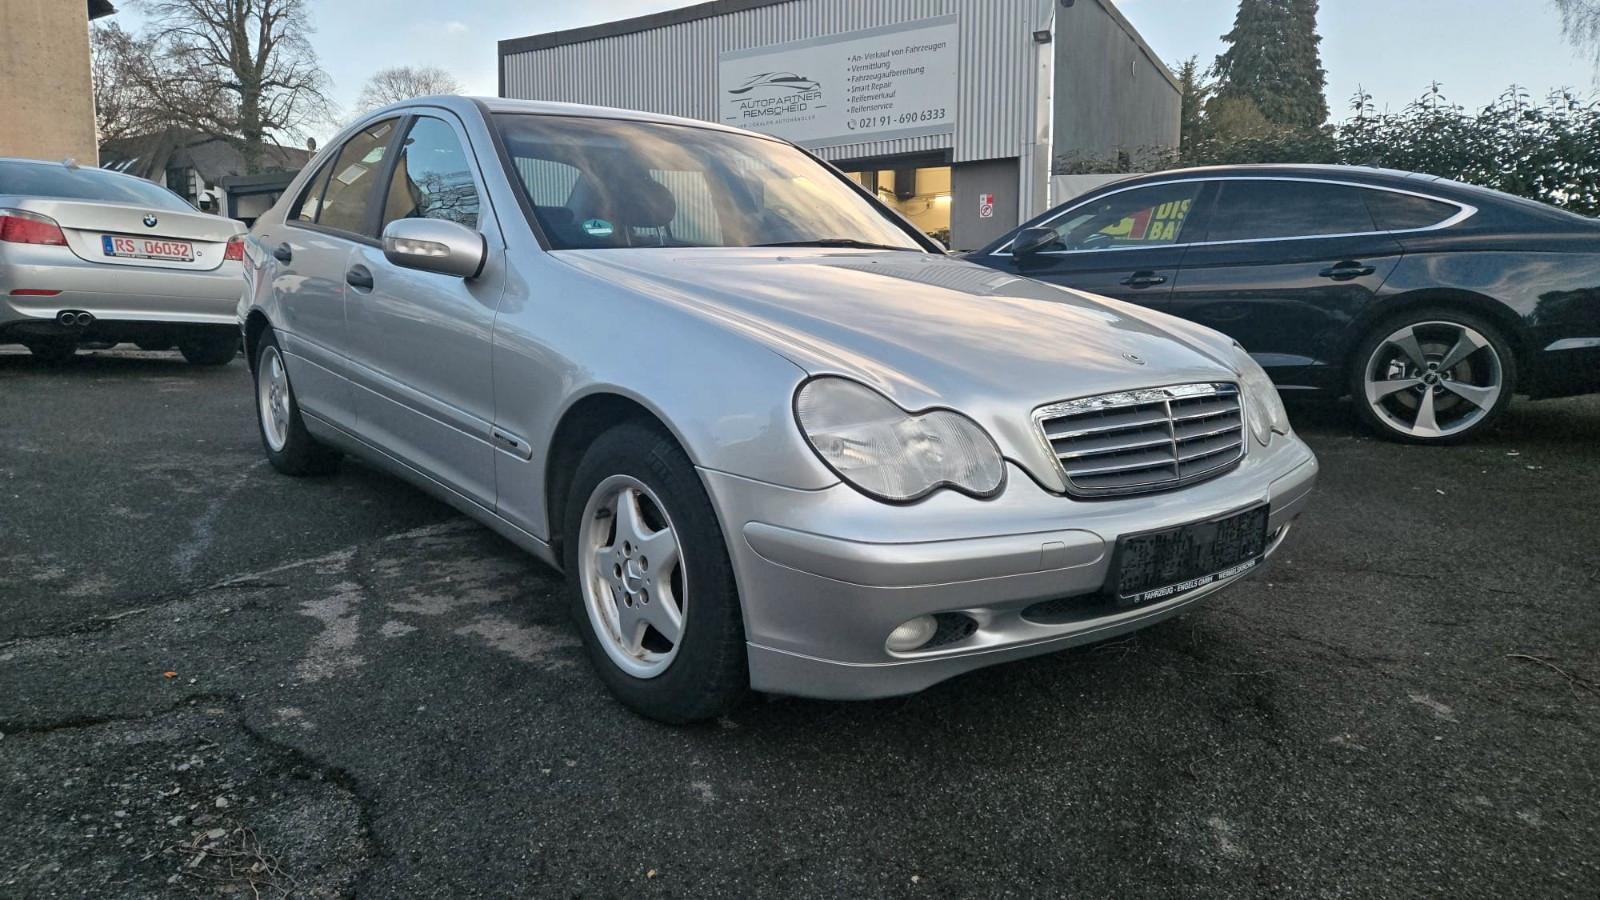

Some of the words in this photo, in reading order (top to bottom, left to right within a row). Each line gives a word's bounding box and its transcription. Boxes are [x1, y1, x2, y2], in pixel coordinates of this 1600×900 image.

[864, 50, 890, 61] Verkauf
[891, 48, 904, 57] von
[905, 42, 946, 55] Fahrzeugen
[851, 61, 891, 72] Vermittlung
[851, 66, 925, 83] Fahrzeugaufbereitung
[851, 84, 870, 93] Smart
[871, 82, 892, 92] Repair
[740, 92, 822, 110] AUTOPARTNER
[851, 91, 896, 103] Reifenverkauf
[743, 103, 808, 119] REMSCHEID
[850, 103, 894, 114] Reifenservice
[859, 117, 876, 129] 021
[880, 115, 891, 126] 91
[899, 112, 918, 124] 690
[920, 108, 946, 121] 6333
[114, 238, 135, 253] RS
[144, 241, 190, 257] 06032
[1144, 585, 1174, 600] FAHRZEUG
[1177, 580, 1198, 592] ENGELS
